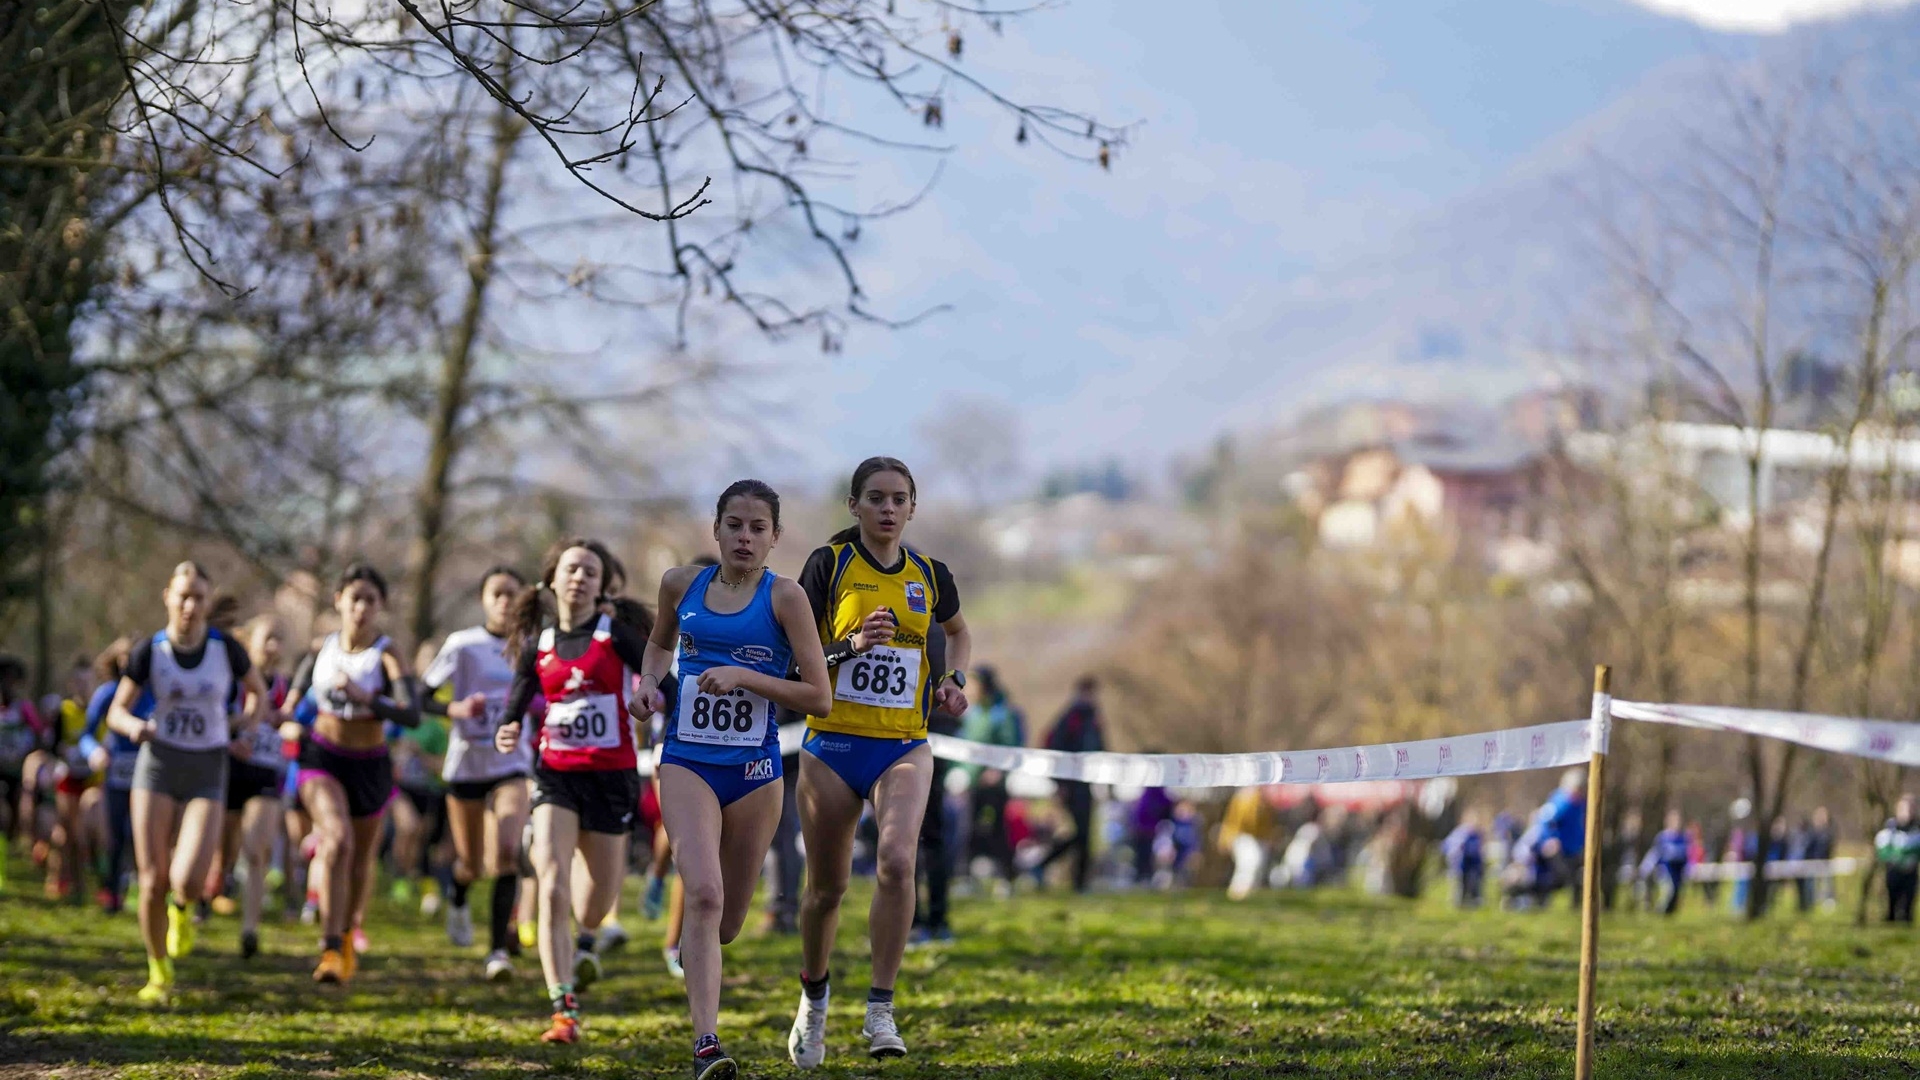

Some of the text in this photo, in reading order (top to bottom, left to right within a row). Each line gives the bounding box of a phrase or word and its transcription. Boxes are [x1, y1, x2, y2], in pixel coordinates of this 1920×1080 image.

[851, 661, 907, 696] 683
[559, 712, 606, 739] 590
[692, 696, 753, 733] 868
[745, 758, 773, 777] DKR
